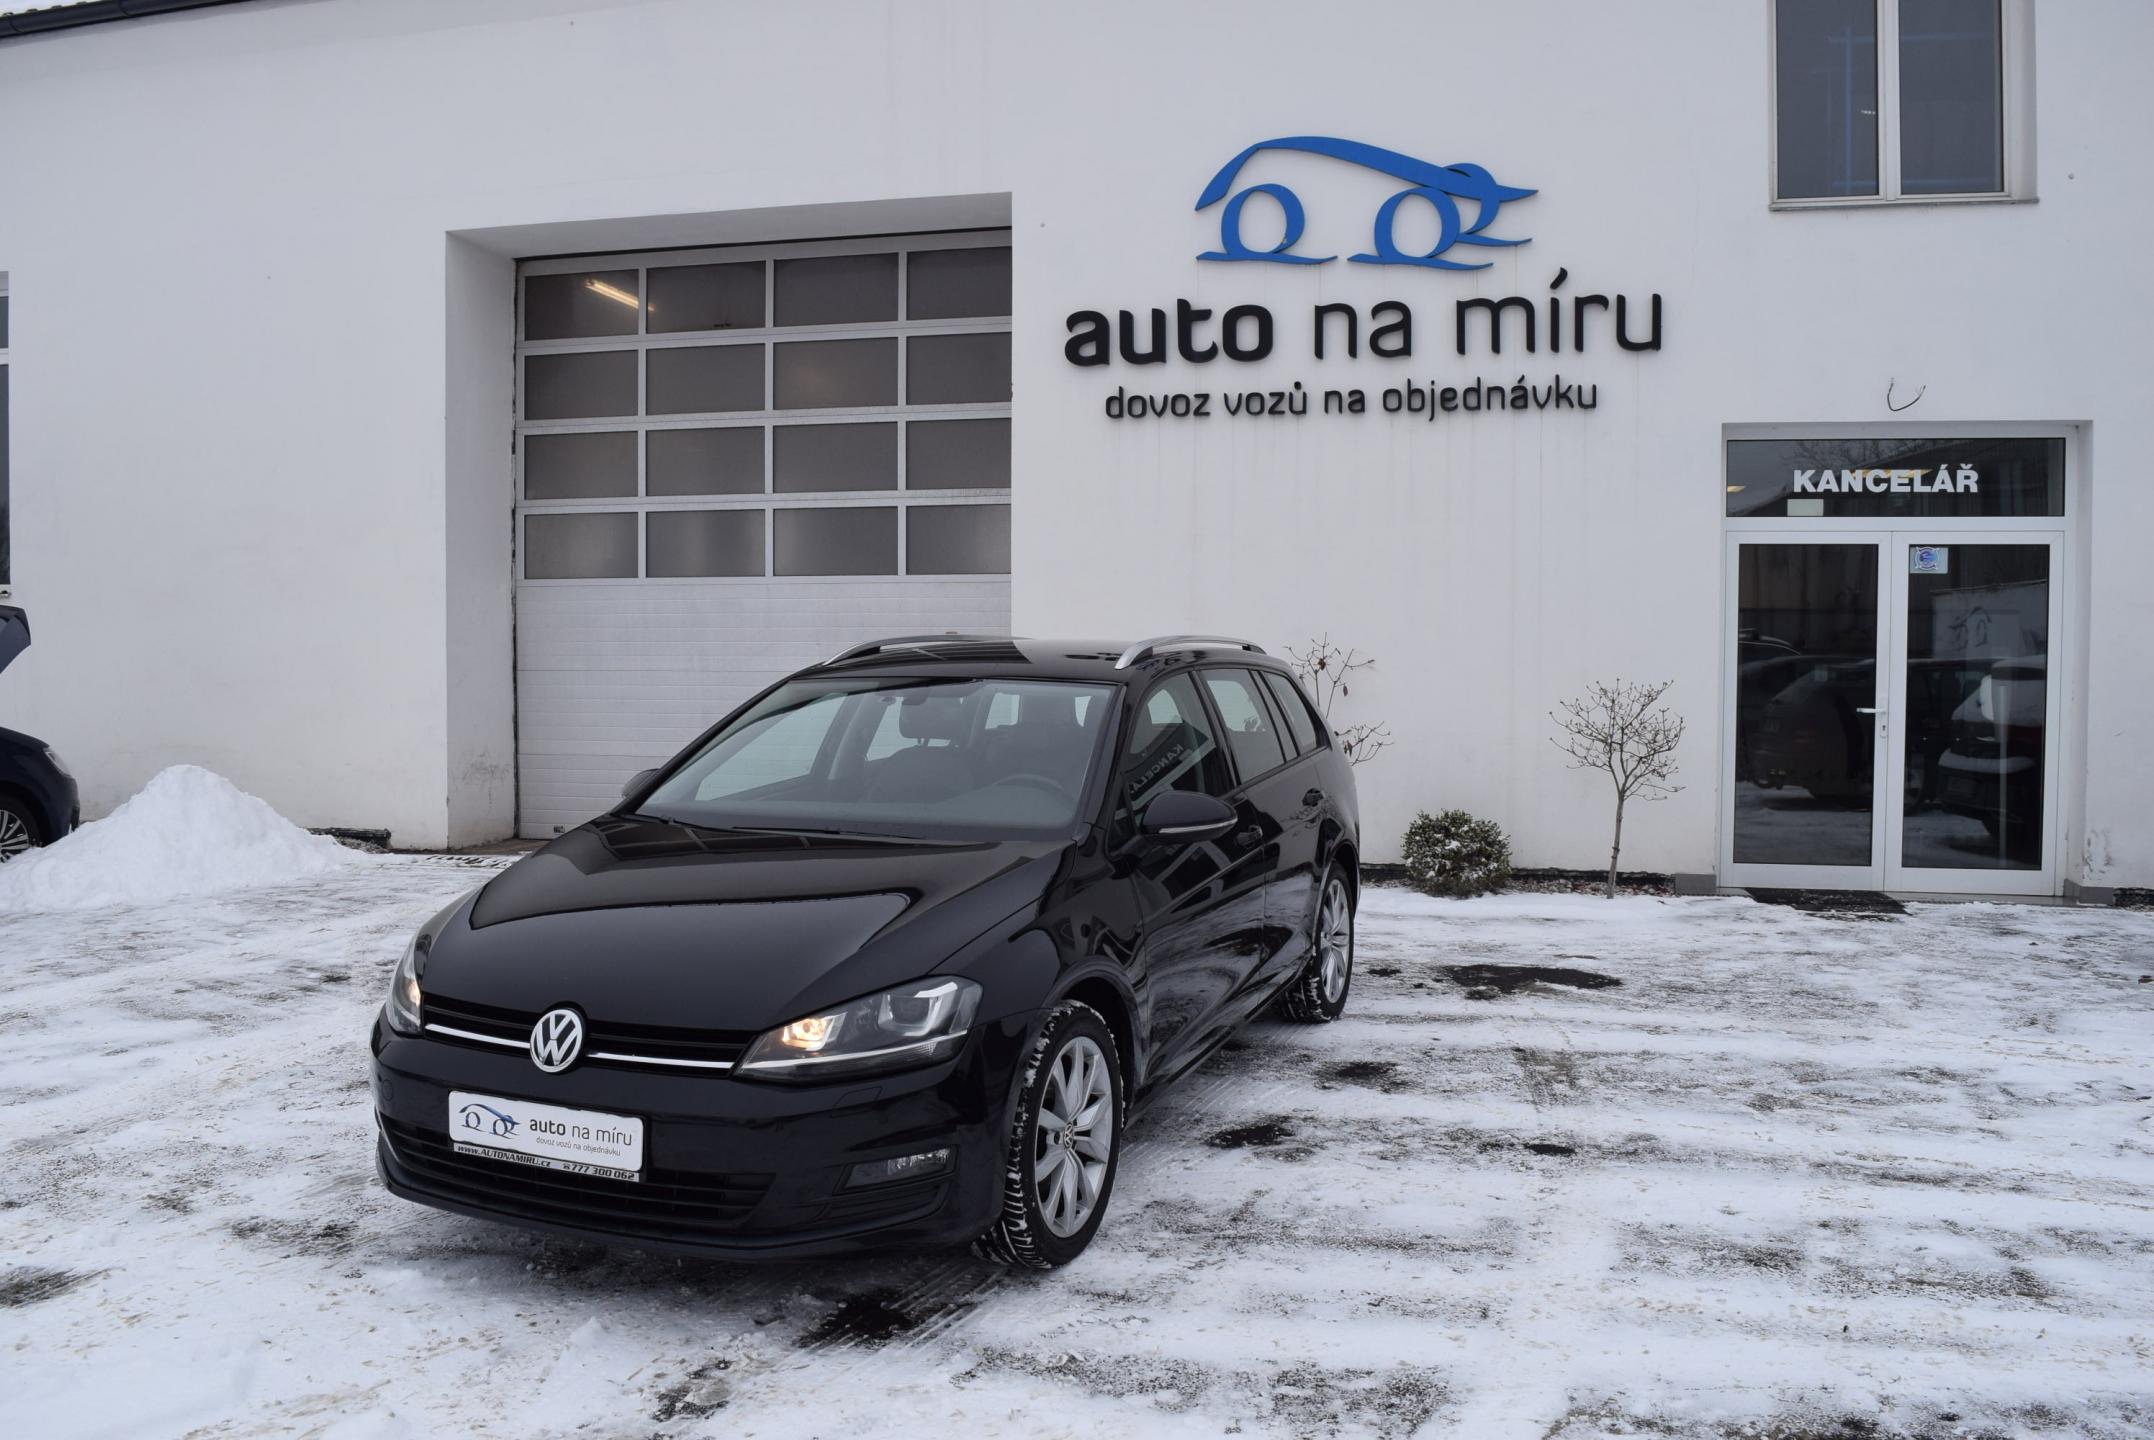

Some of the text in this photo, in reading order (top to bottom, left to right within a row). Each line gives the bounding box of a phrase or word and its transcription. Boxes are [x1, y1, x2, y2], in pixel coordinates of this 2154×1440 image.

[1064, 267, 1663, 366] auto na míru
[1104, 374, 1598, 422] dovoz vozů na objednávku
[1792, 463, 1980, 493] KANCELÁŘ
[530, 1009, 582, 1072] VW
[529, 1119, 632, 1146] auto na míru
[536, 1136, 555, 1146] dovoz
[573, 1142, 582, 1150] na
[583, 1144, 621, 1156] objednávku
[592, 1166, 612, 1177] 300
